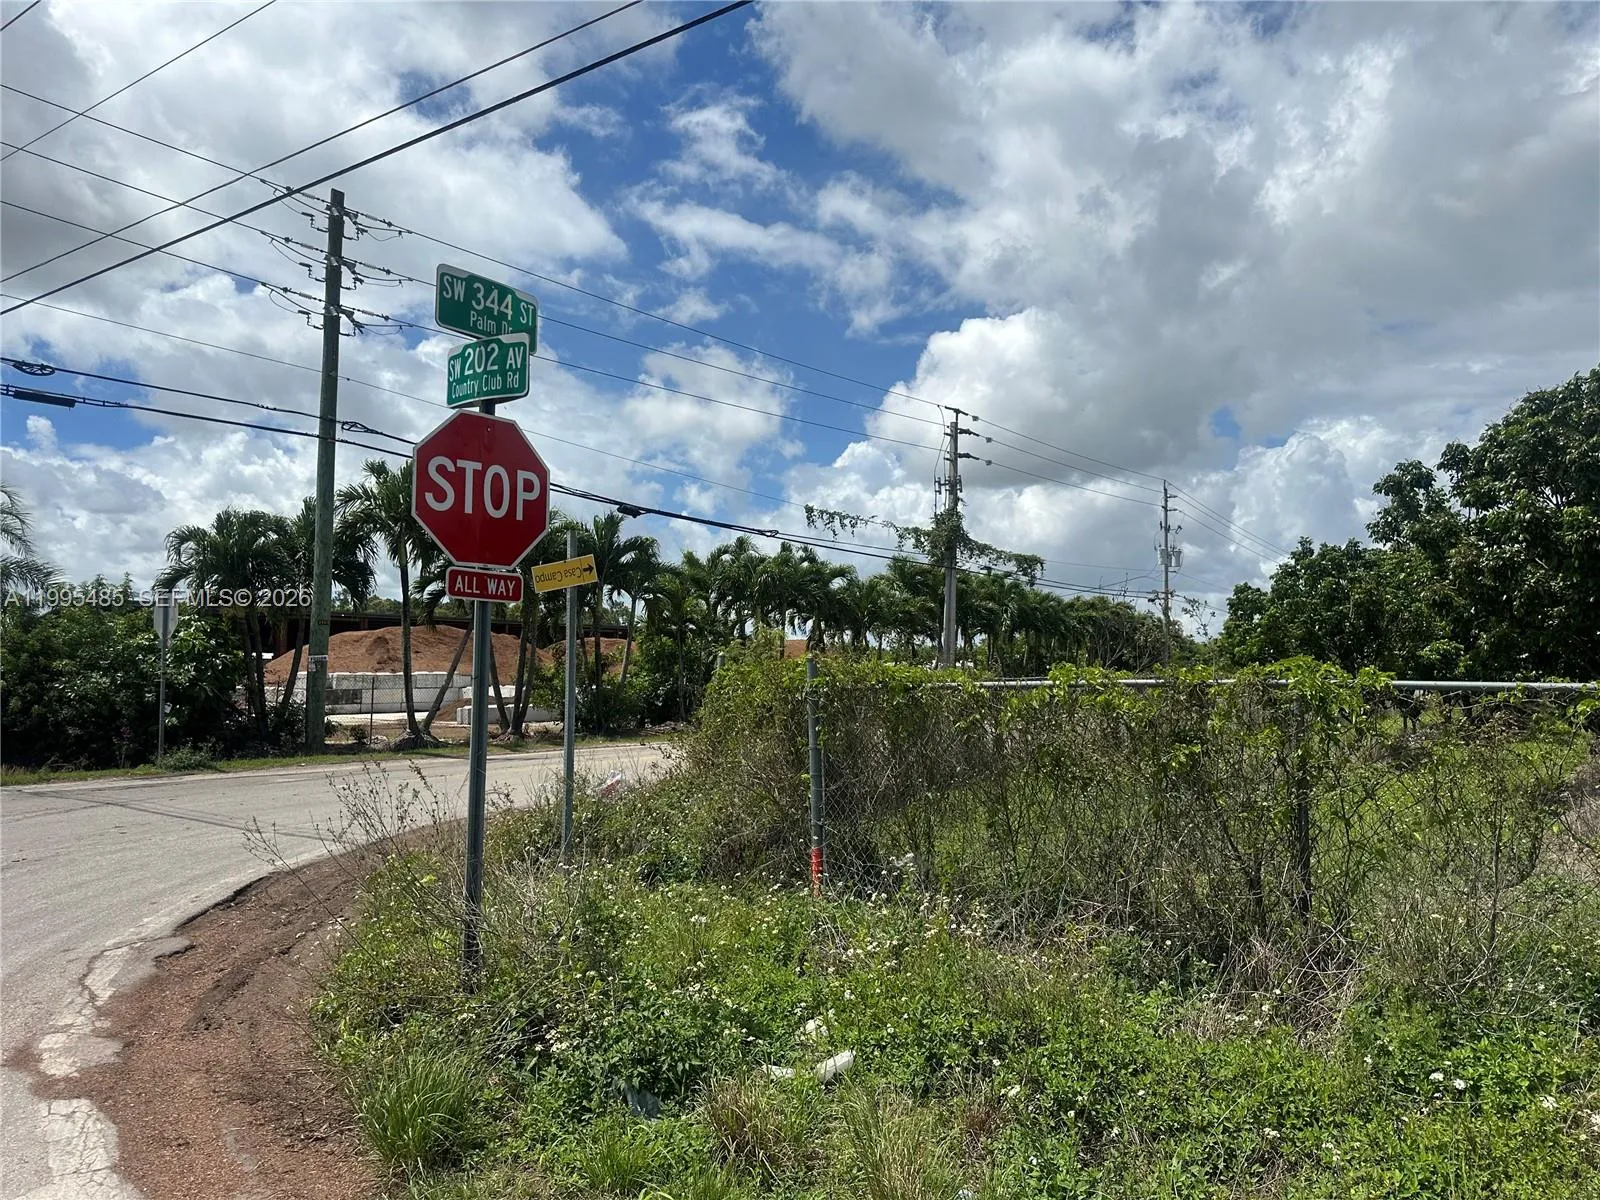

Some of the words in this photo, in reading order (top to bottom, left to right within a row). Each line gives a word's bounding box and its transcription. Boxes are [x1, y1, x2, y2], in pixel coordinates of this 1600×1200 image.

[442, 275, 466, 302] SW
[472, 282, 513, 321] 344
[519, 302, 534, 326] ST
[470, 310, 497, 335] Palm
[501, 320, 513, 335] Dr
[449, 357, 462, 382] SW
[464, 343, 499, 375] 202
[506, 346, 524, 370] AV
[452, 379, 479, 399] Country
[482, 373, 503, 392] Club
[506, 371, 520, 389] Rd
[424, 455, 541, 521] STOP
[534, 571, 563, 584] Campo
[563, 566, 583, 579] Casa
[454, 575, 481, 594] ALL
[487, 578, 516, 597] WAY
